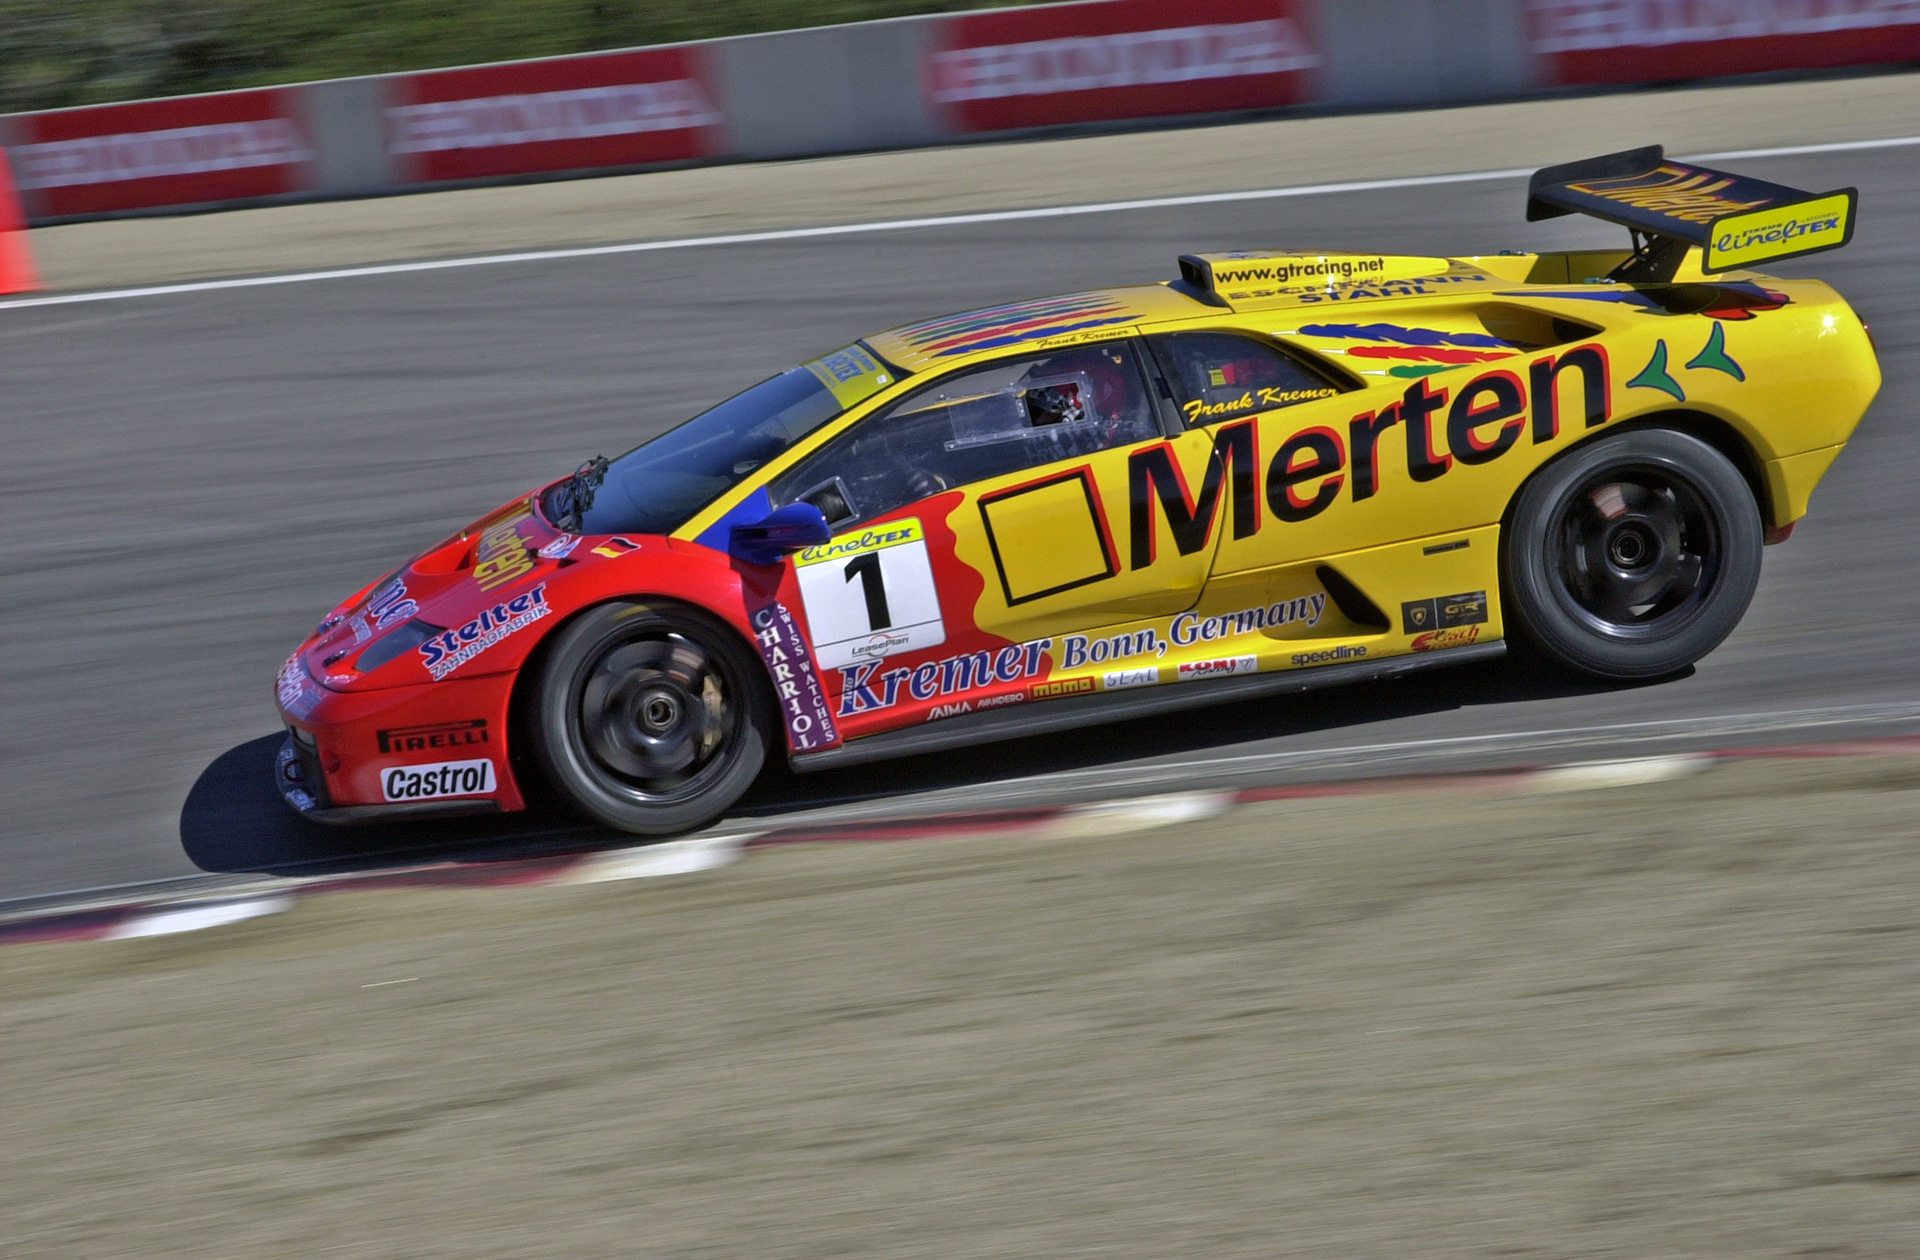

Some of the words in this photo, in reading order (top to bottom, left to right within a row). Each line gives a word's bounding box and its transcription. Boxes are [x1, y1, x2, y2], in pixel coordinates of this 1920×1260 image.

[1215, 257, 1385, 283] www.gtracing.net
[1299, 285, 1437, 303] STAHL
[1183, 391, 1255, 423] Frank
[1257, 386, 1340, 405] Kremer
[1128, 342, 1612, 572] Merten
[844, 551, 892, 632] 1
[419, 582, 546, 669] Stelter
[836, 638, 1053, 718] Kremer
[1062, 628, 1167, 670] Bonn,
[1170, 592, 1327, 647] Germany
[851, 636, 910, 656] LeasePlan
[1291, 645, 1367, 666] speedline
[755, 609, 817, 750] CHARRIOL
[776, 602, 805, 656] SWISS
[799, 660, 834, 743] WATCHES
[376, 719, 489, 754] PIRELLI
[386, 762, 488, 799] Castrol
